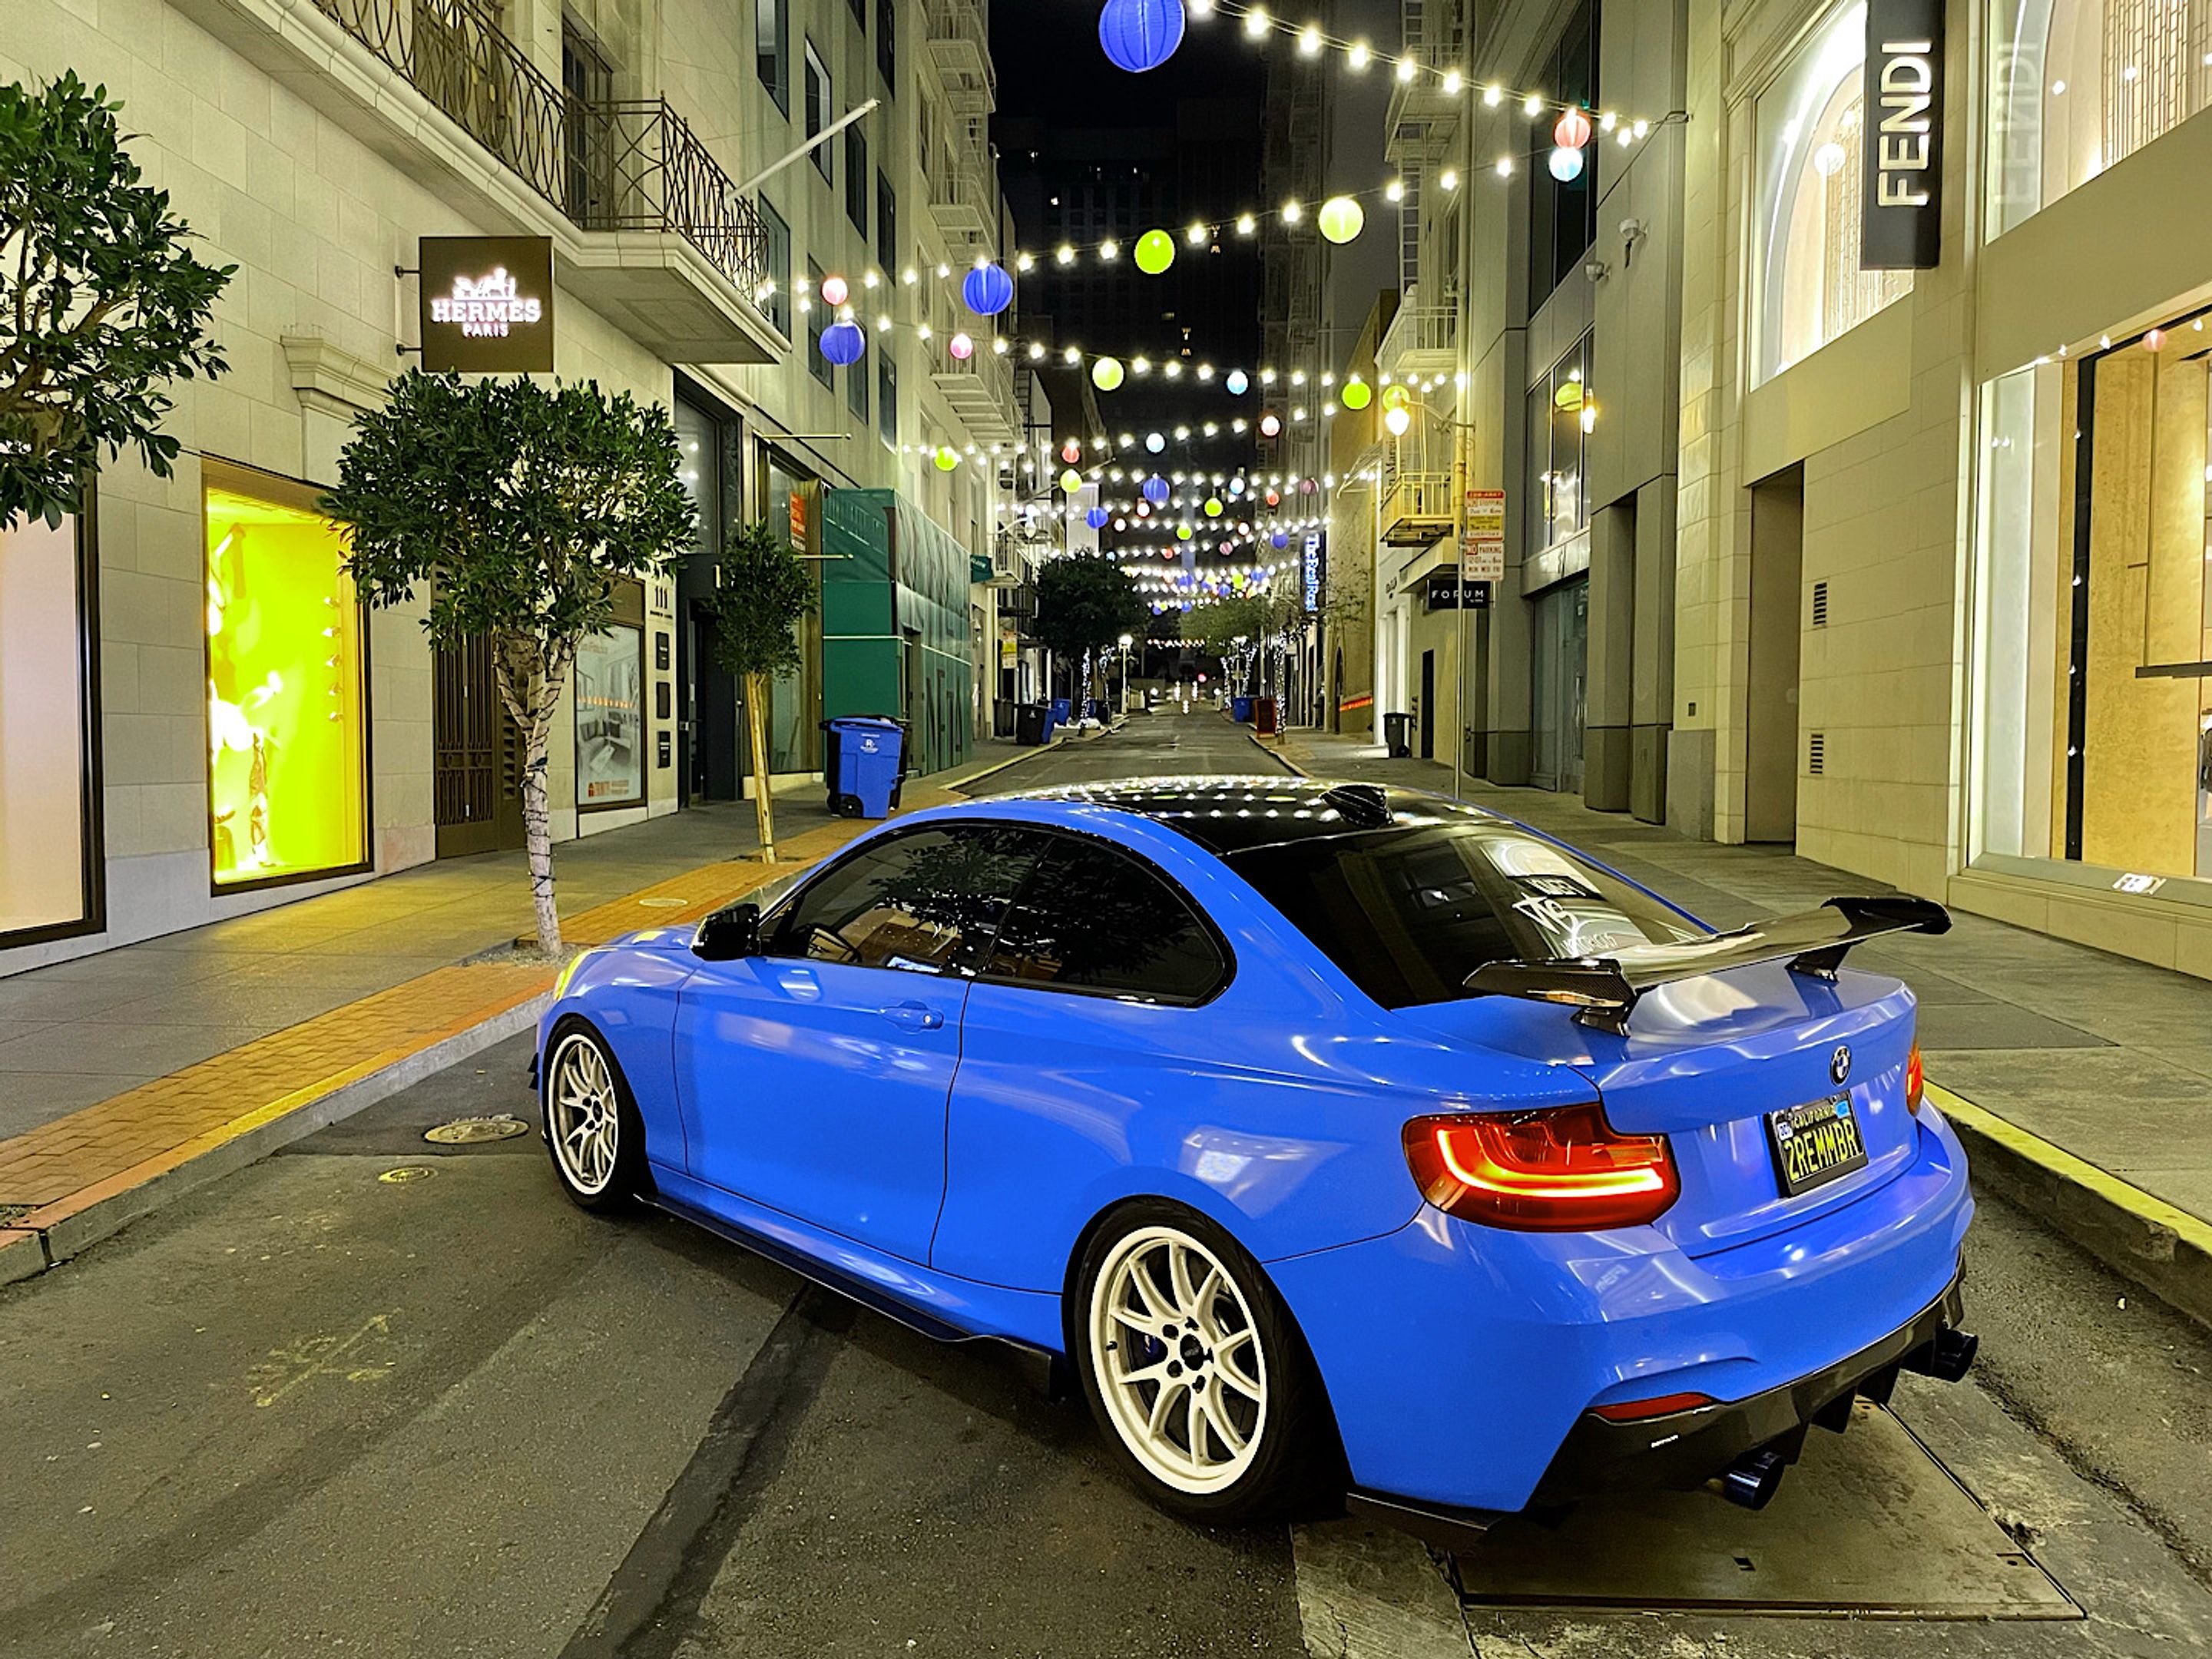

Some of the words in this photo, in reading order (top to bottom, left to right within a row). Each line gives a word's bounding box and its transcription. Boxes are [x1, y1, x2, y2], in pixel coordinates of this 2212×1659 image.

[1878, 42, 1932, 207] FENDI
[462, 323, 508, 336] PARIS
[1783, 1118, 1860, 1181] 2REMMBR
